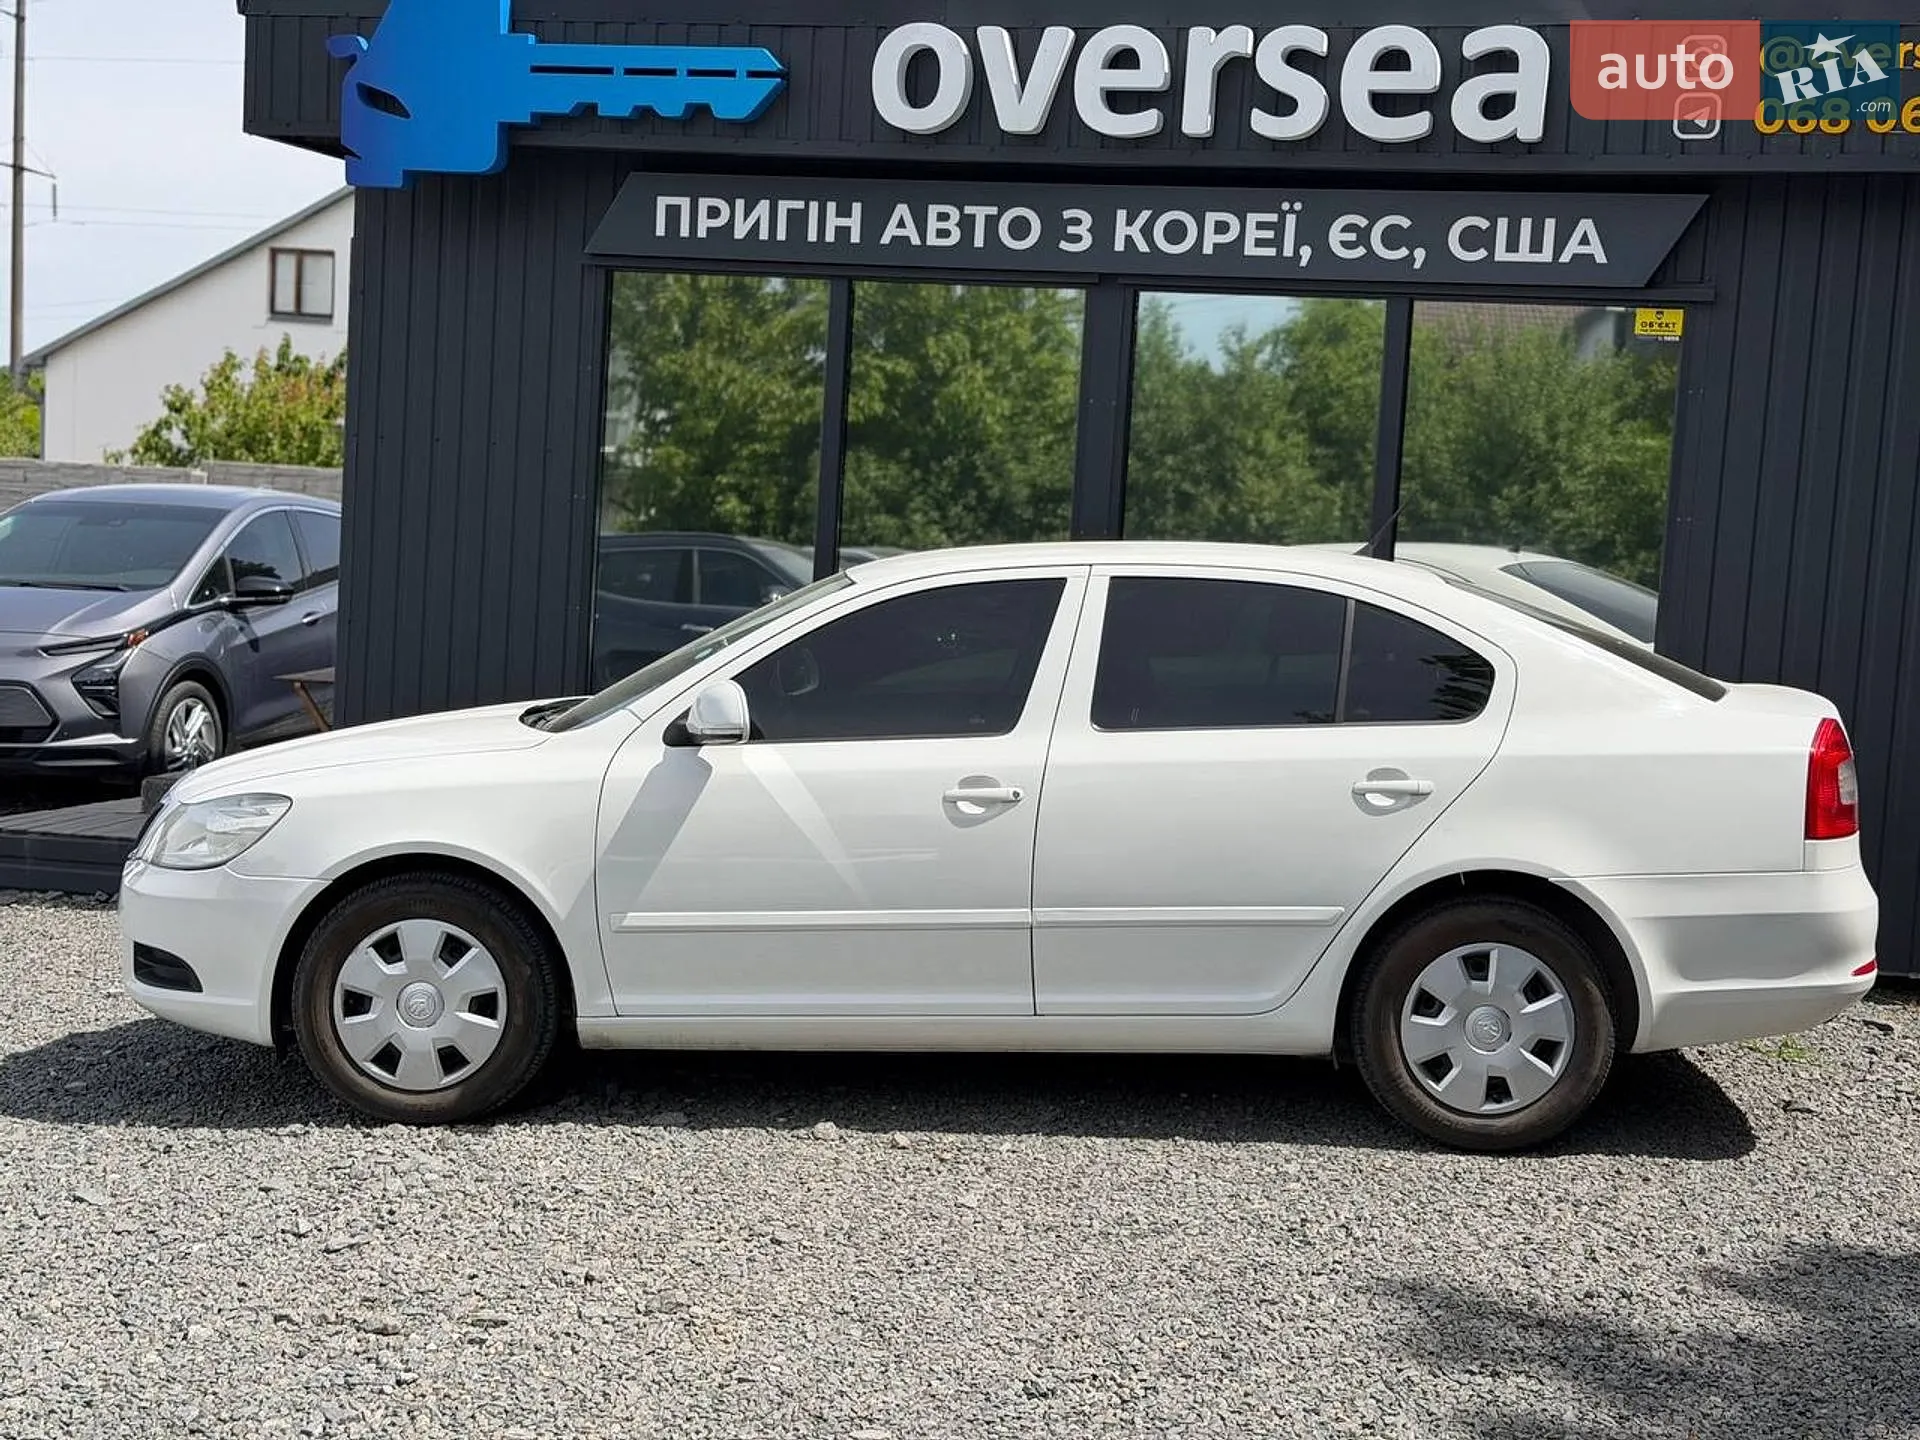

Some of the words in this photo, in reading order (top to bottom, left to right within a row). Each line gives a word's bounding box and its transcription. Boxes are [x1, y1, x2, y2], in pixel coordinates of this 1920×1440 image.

[871, 21, 1551, 143] oversea
[1754, 97, 1851, 134] 068
[654, 195, 863, 243] ПРИГІН
[879, 203, 1042, 251] АВТО
[1058, 208, 1093, 253] З
[1113, 201, 1313, 267] КОРЕЇ,
[1328, 214, 1427, 269] ЄС,
[1448, 216, 1608, 264] США
